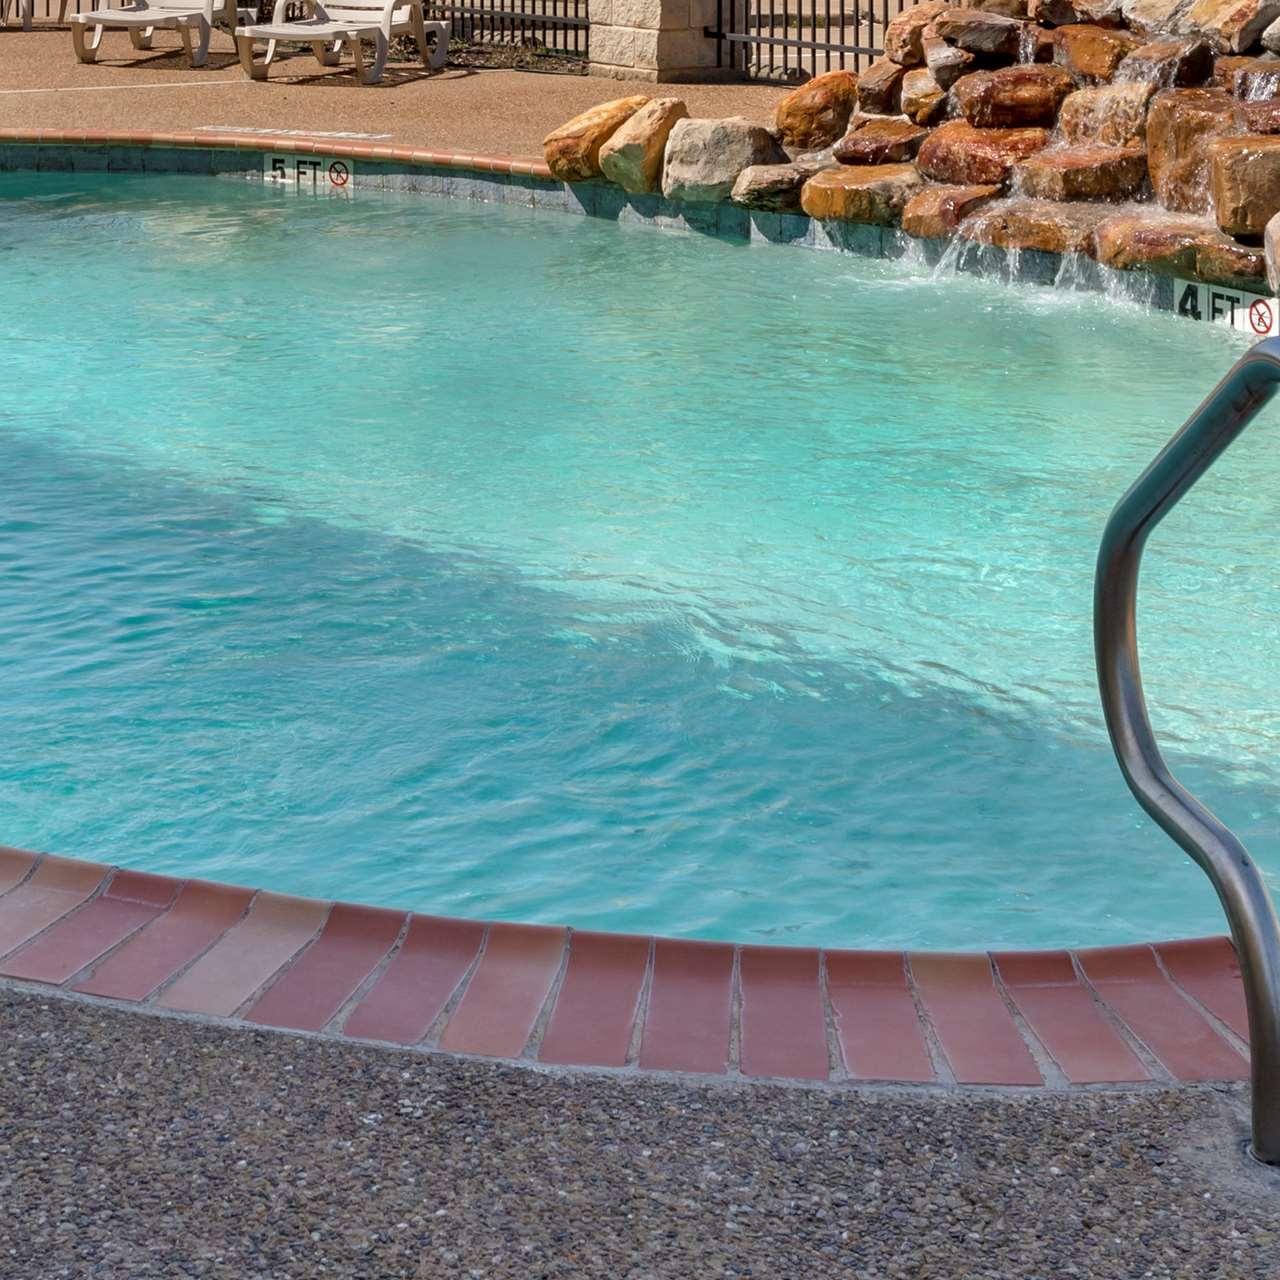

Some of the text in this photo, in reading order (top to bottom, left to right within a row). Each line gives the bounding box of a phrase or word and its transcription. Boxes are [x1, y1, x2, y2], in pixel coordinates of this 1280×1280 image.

[271, 158, 322, 184] 5 FT
[1179, 284, 1240, 326] 4 FT
